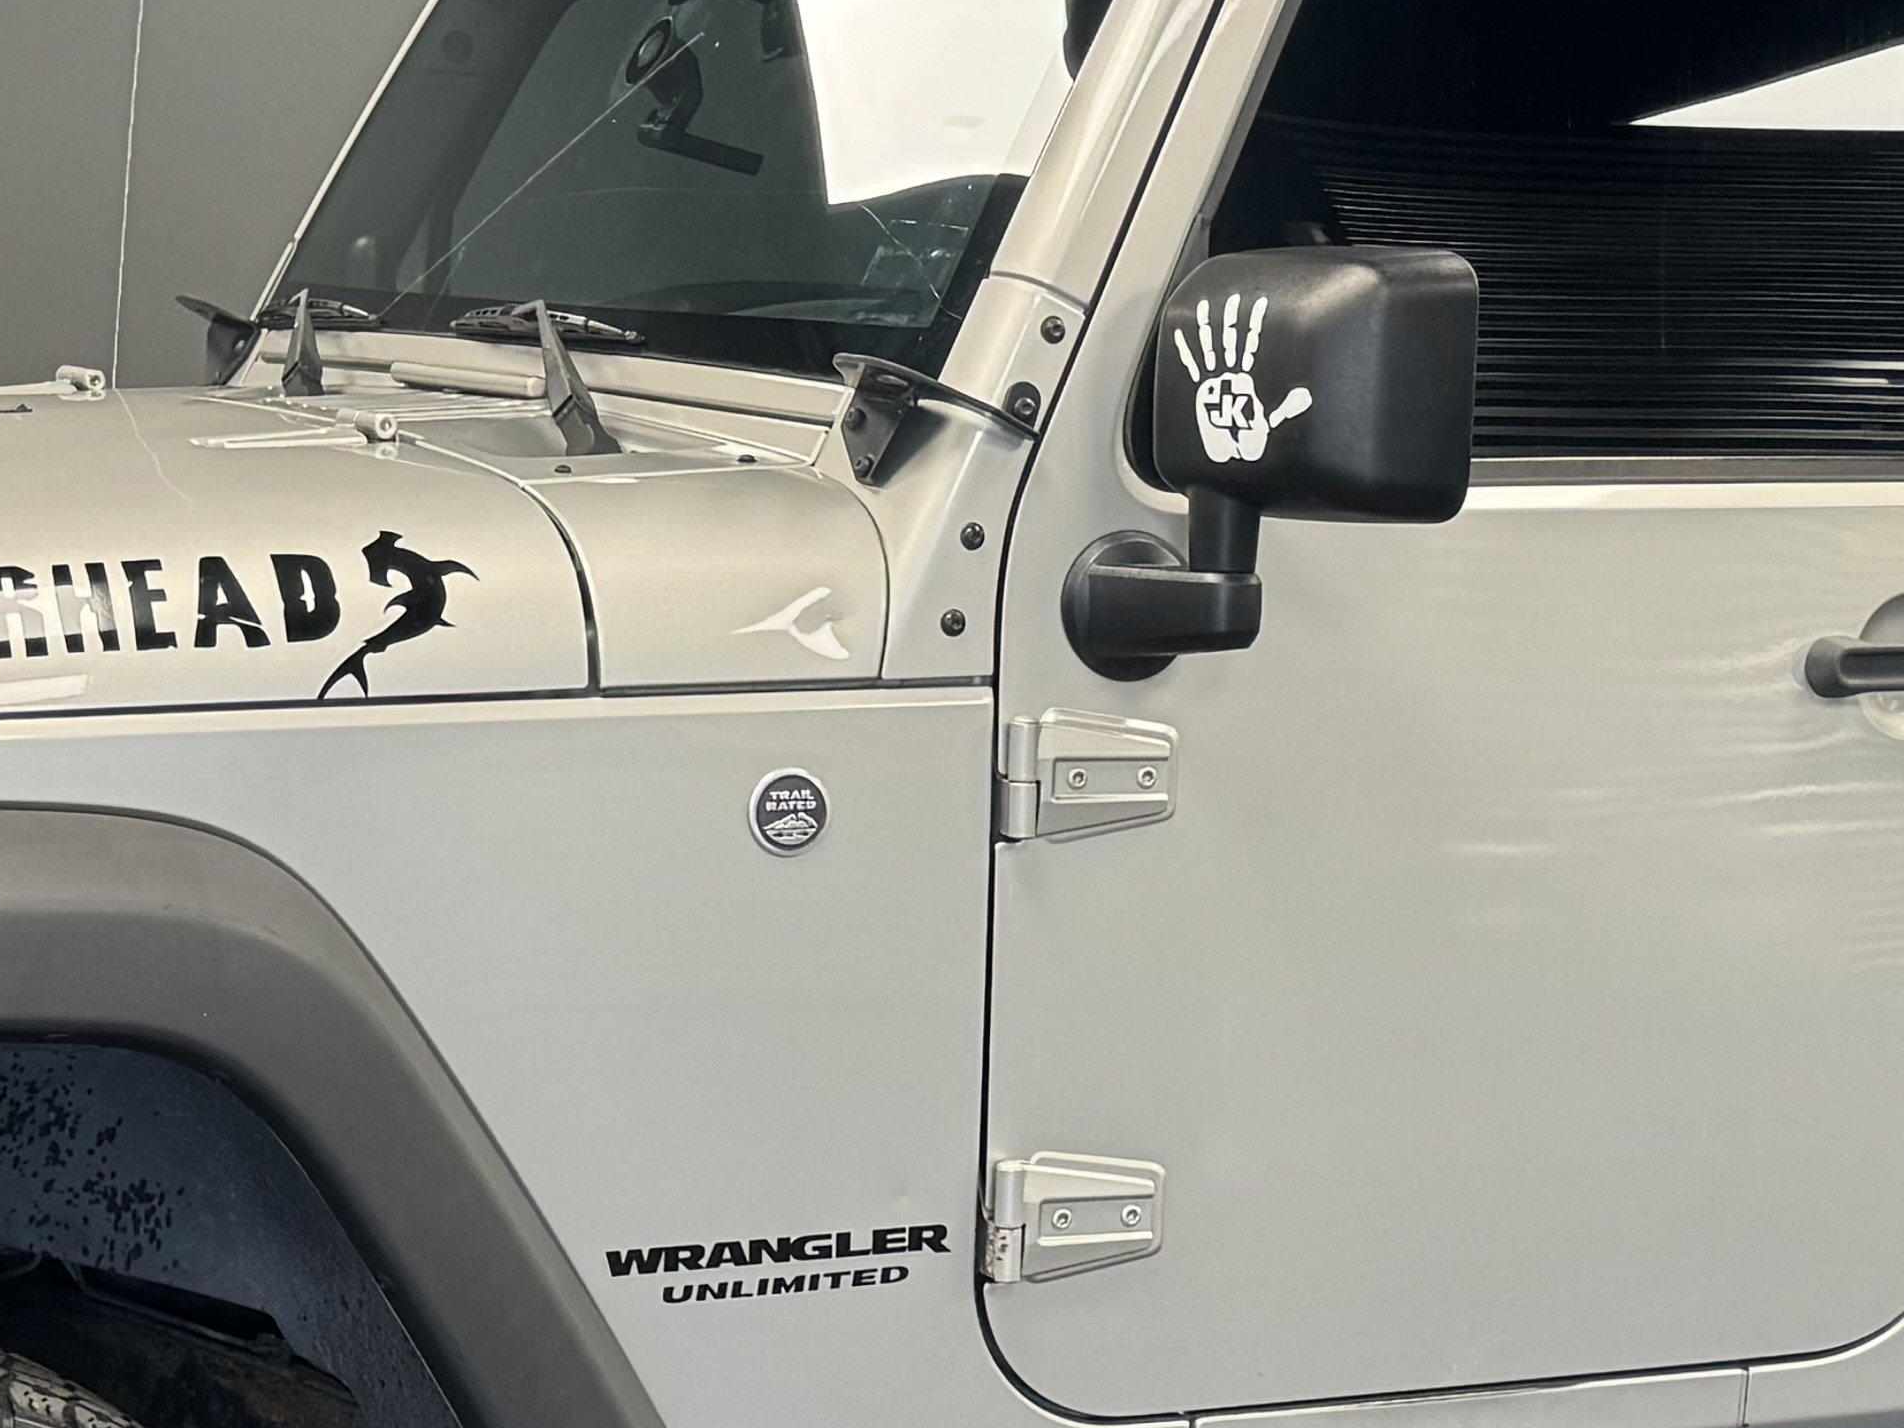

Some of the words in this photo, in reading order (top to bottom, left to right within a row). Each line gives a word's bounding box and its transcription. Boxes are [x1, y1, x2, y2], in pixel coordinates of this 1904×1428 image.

[1209, 393, 1252, 428] JK
[765, 800, 817, 812] RATED
[768, 789, 815, 801] TRAIL
[605, 1223, 952, 1278] WRANGLER
[662, 1265, 910, 1304] UNLIMITED
